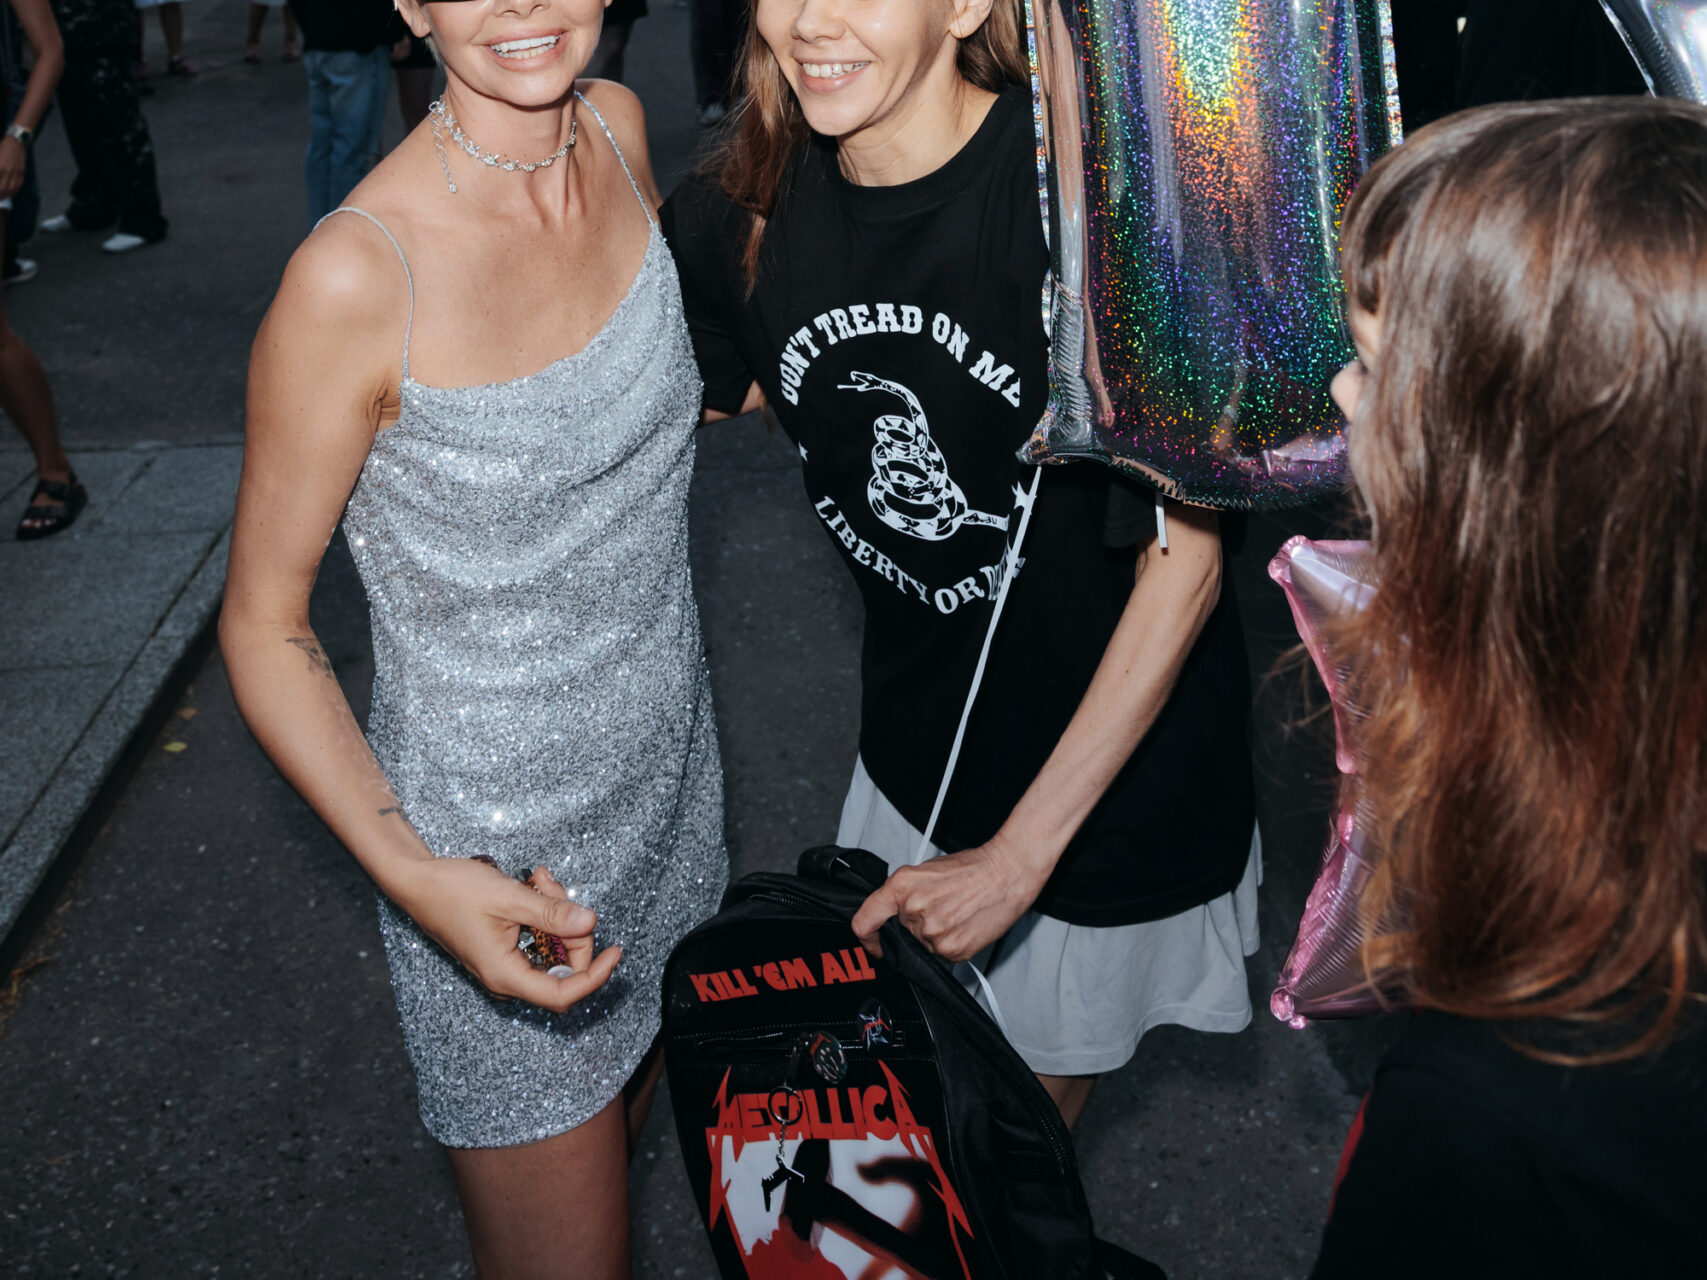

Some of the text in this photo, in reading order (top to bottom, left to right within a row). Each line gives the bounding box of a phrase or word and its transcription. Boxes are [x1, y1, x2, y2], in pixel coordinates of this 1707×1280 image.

[779, 326, 821, 406] DON'T
[813, 302, 923, 346] TREAD
[932, 312, 970, 364] ON
[814, 495, 930, 605] LIBERTY
[934, 576, 985, 614] OR
[690, 967, 759, 1003] KILL
[820, 946, 877, 985] ALL
